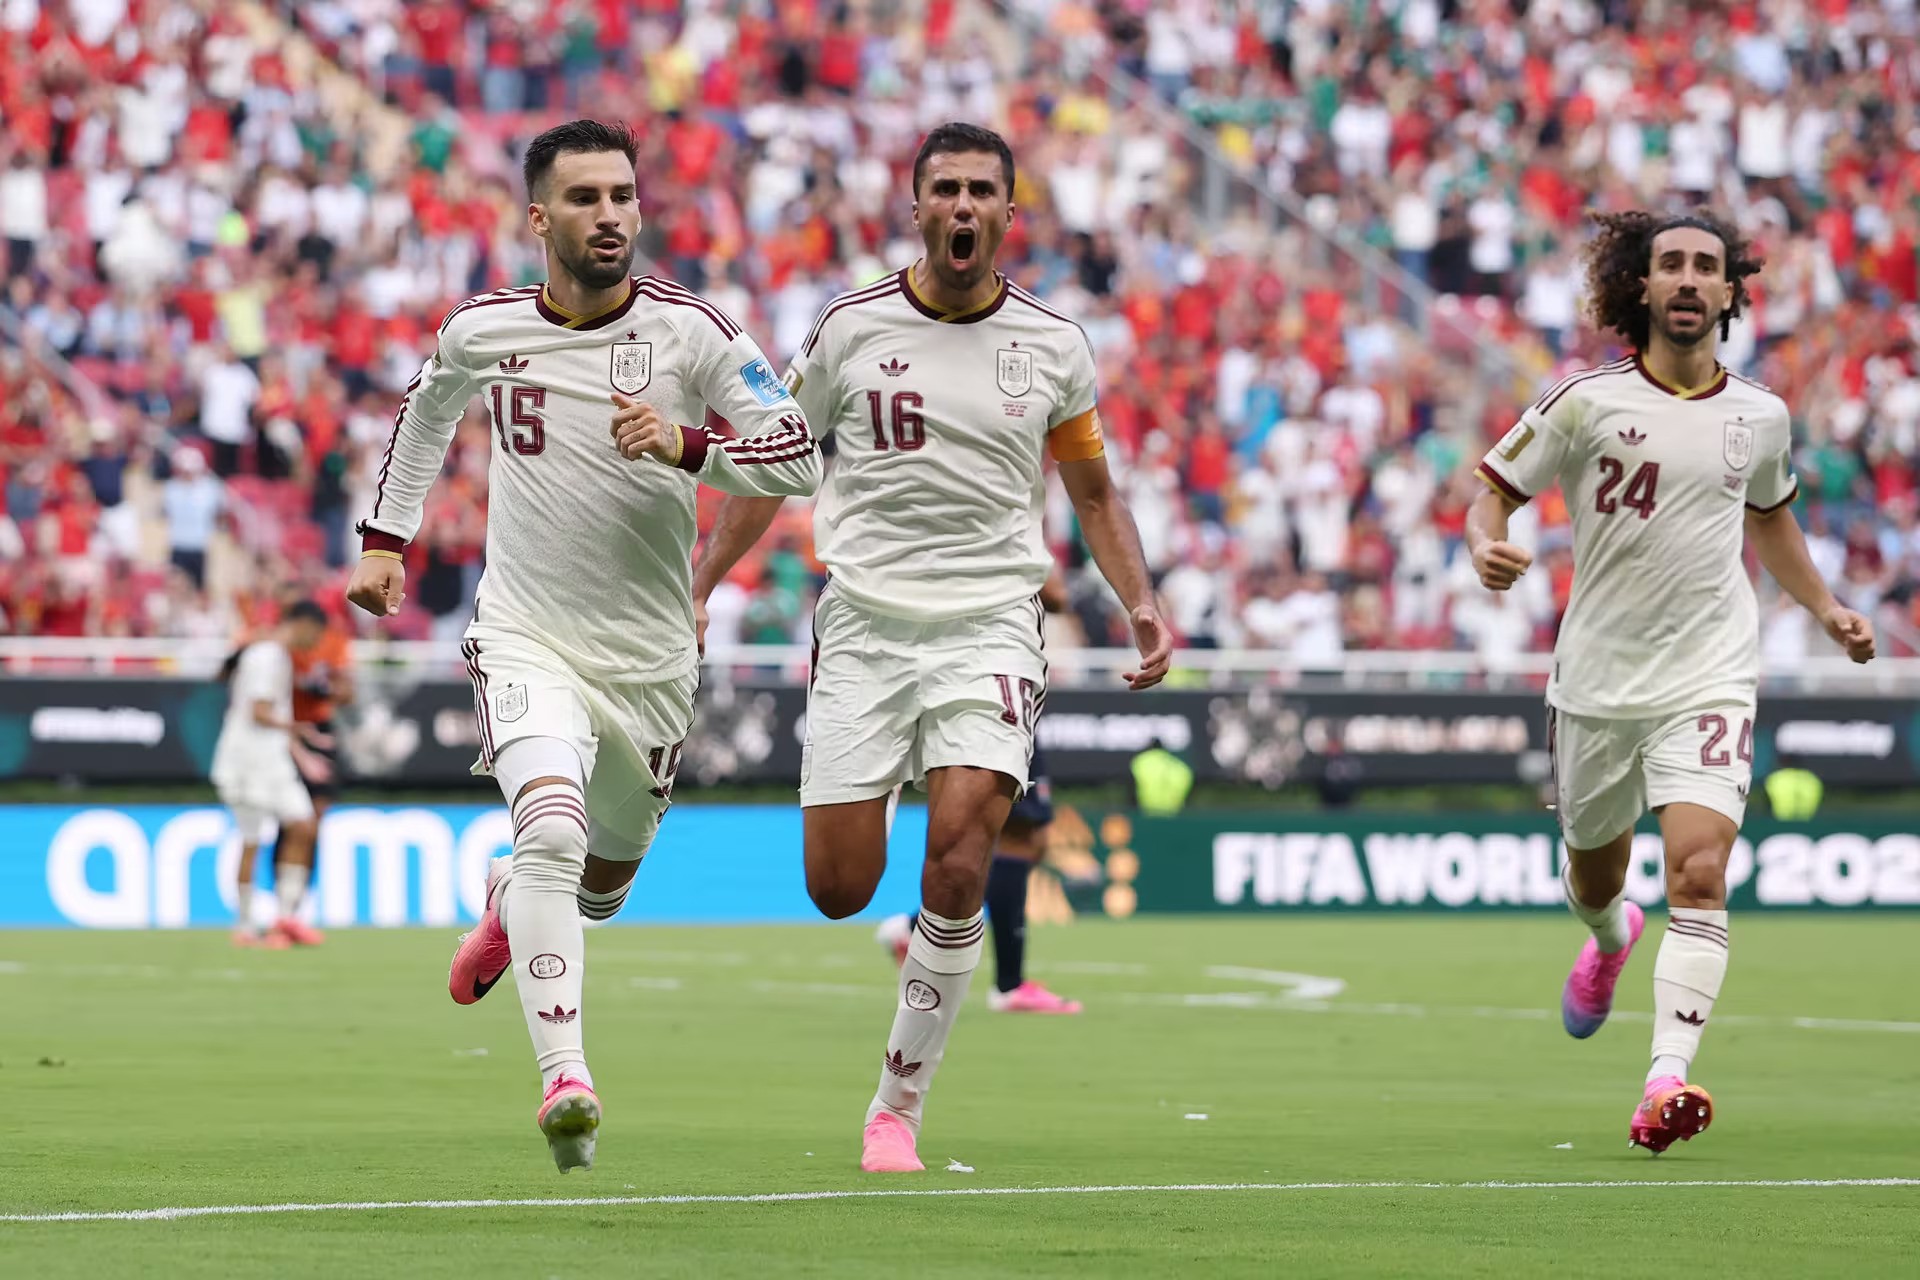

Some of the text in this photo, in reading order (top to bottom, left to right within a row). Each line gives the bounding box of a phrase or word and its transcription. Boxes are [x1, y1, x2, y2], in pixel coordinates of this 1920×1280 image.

[491, 385, 546, 456] 15
[867, 390, 926, 452] 16
[1596, 456, 1660, 520] 24
[1698, 714, 1753, 767] 24
[46, 809, 606, 928] aramc
[1212, 832, 1920, 906] FIFA WORL CP 202
